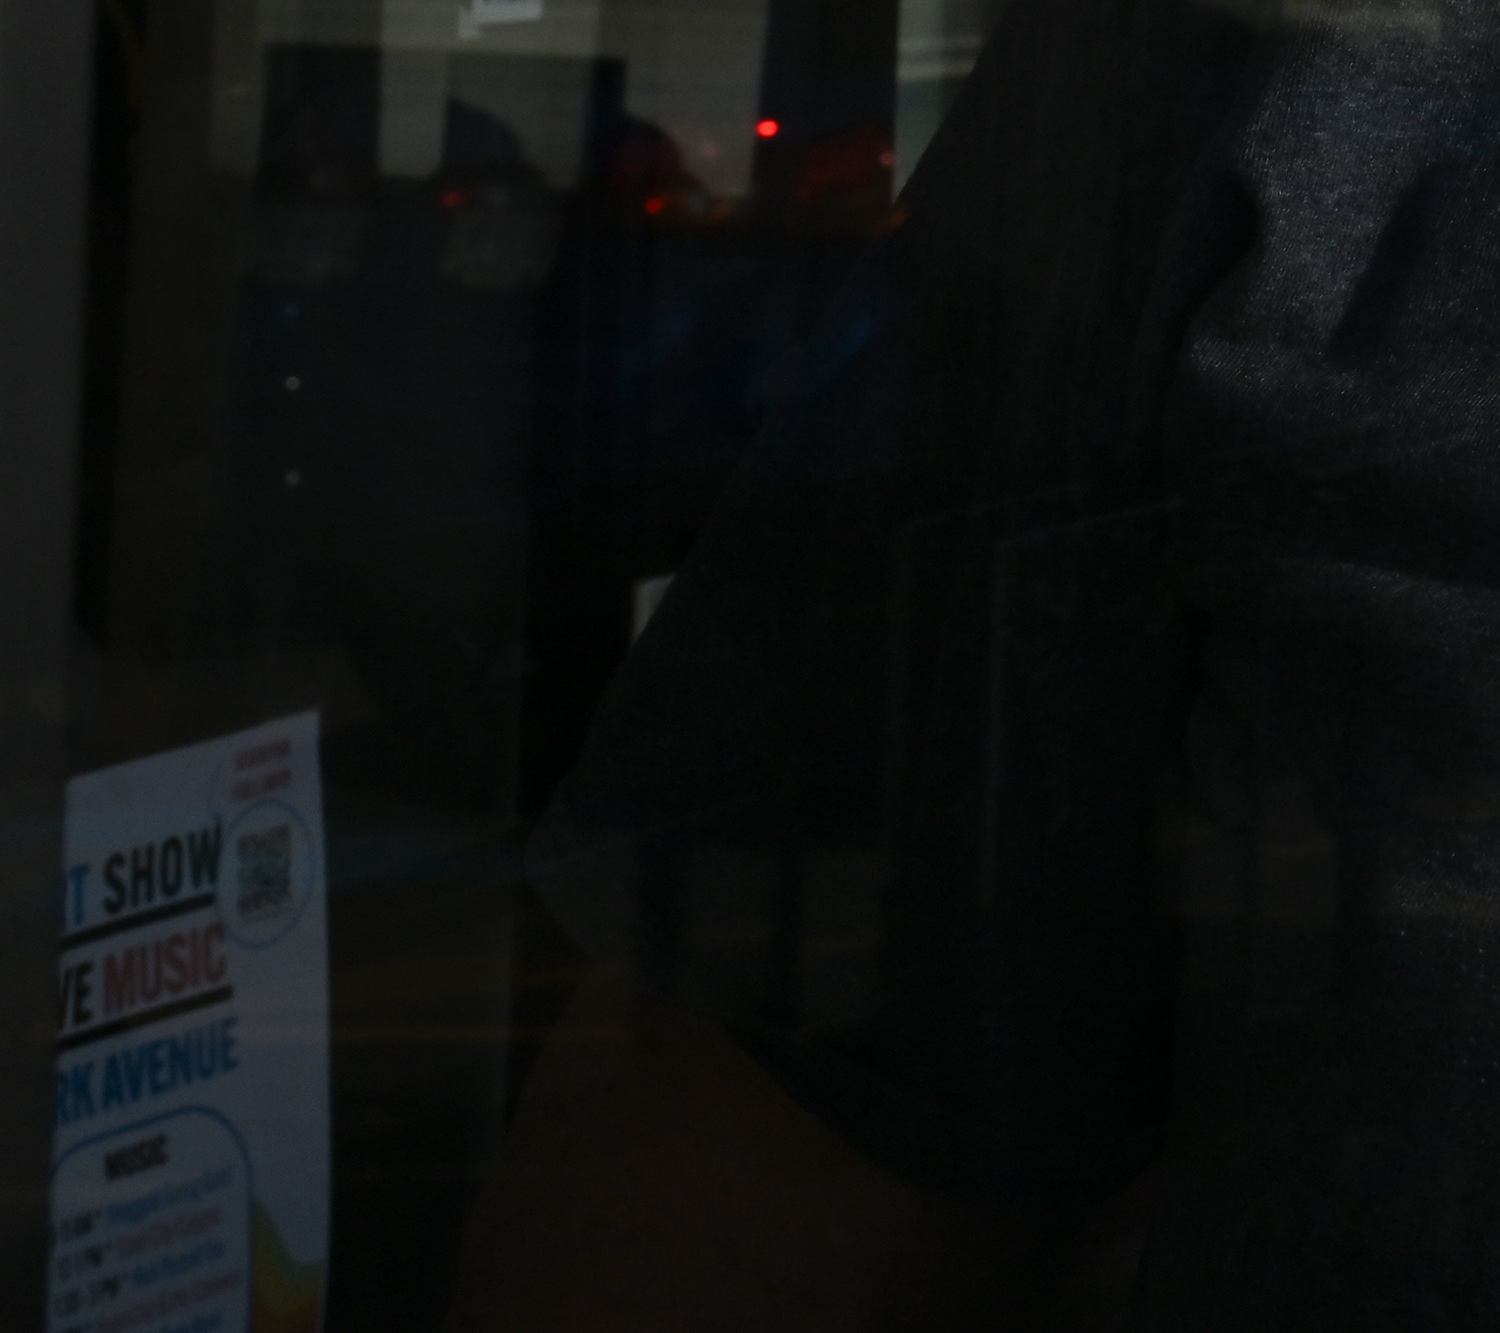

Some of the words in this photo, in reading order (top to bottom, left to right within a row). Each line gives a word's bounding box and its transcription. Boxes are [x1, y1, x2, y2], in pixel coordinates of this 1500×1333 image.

[103, 824, 223, 915] SHOW
[102, 921, 227, 1015] MUSIC
[102, 1015, 240, 1112] AVENUE
